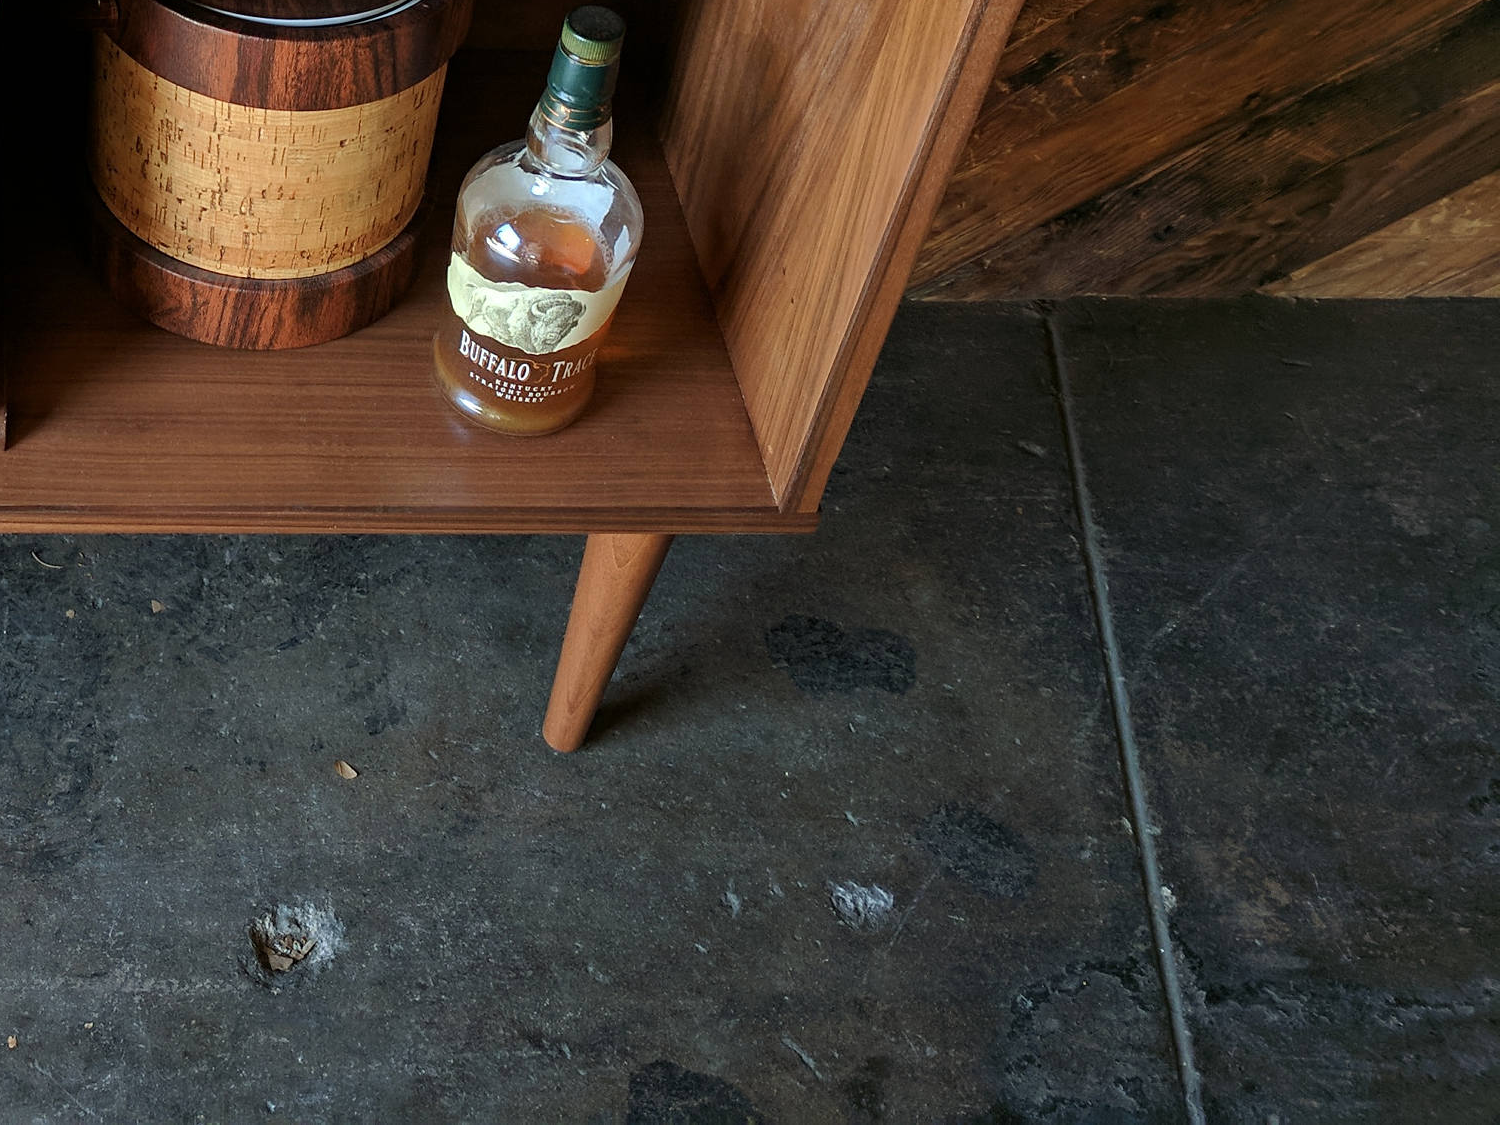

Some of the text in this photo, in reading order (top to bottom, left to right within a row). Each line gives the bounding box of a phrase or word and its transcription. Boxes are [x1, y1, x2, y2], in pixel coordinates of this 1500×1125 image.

[459, 330, 530, 382] BUFFALO
[469, 371, 522, 396] STRAIGHT
[495, 379, 553, 392] KENTUCKY
[495, 391, 544, 403] WHISKEY
